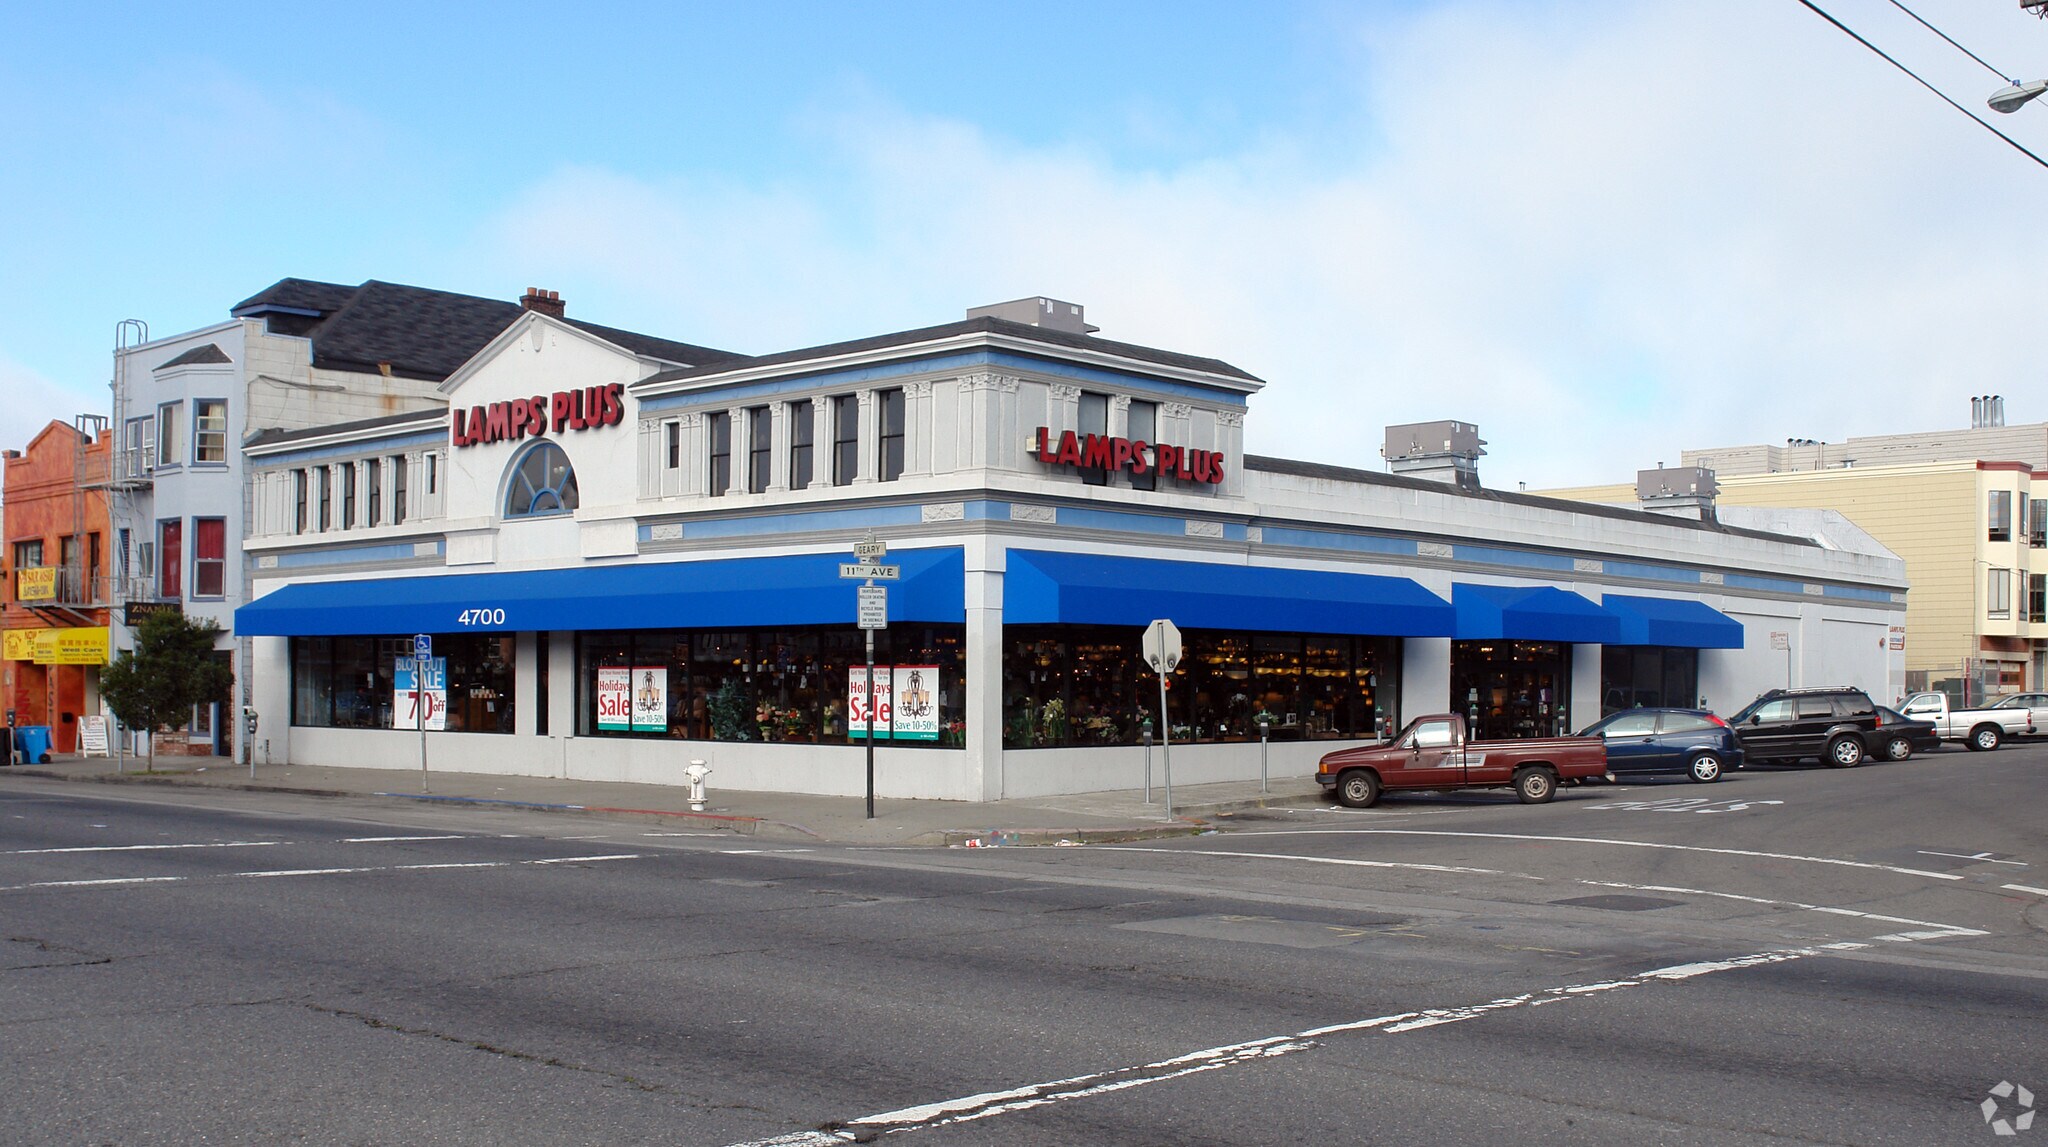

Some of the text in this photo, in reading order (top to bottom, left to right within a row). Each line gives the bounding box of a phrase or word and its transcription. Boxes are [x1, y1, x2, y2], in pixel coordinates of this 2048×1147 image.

[453, 382, 625, 447] LAMPS PLUS
[1037, 426, 1224, 484] LAMPS PLUS
[858, 545, 881, 554] GEARY
[846, 567, 893, 576] 11TH AVE
[458, 608, 506, 626] 4700
[599, 680, 630, 694] Holidays
[851, 680, 891, 697] Holays
[433, 700, 445, 712] off
[600, 692, 630, 716] Sale
[851, 695, 891, 722] Sale
[633, 714, 646, 723] Save
[895, 720, 910, 730] Save
[912, 720, 937, 730] 10-50%
